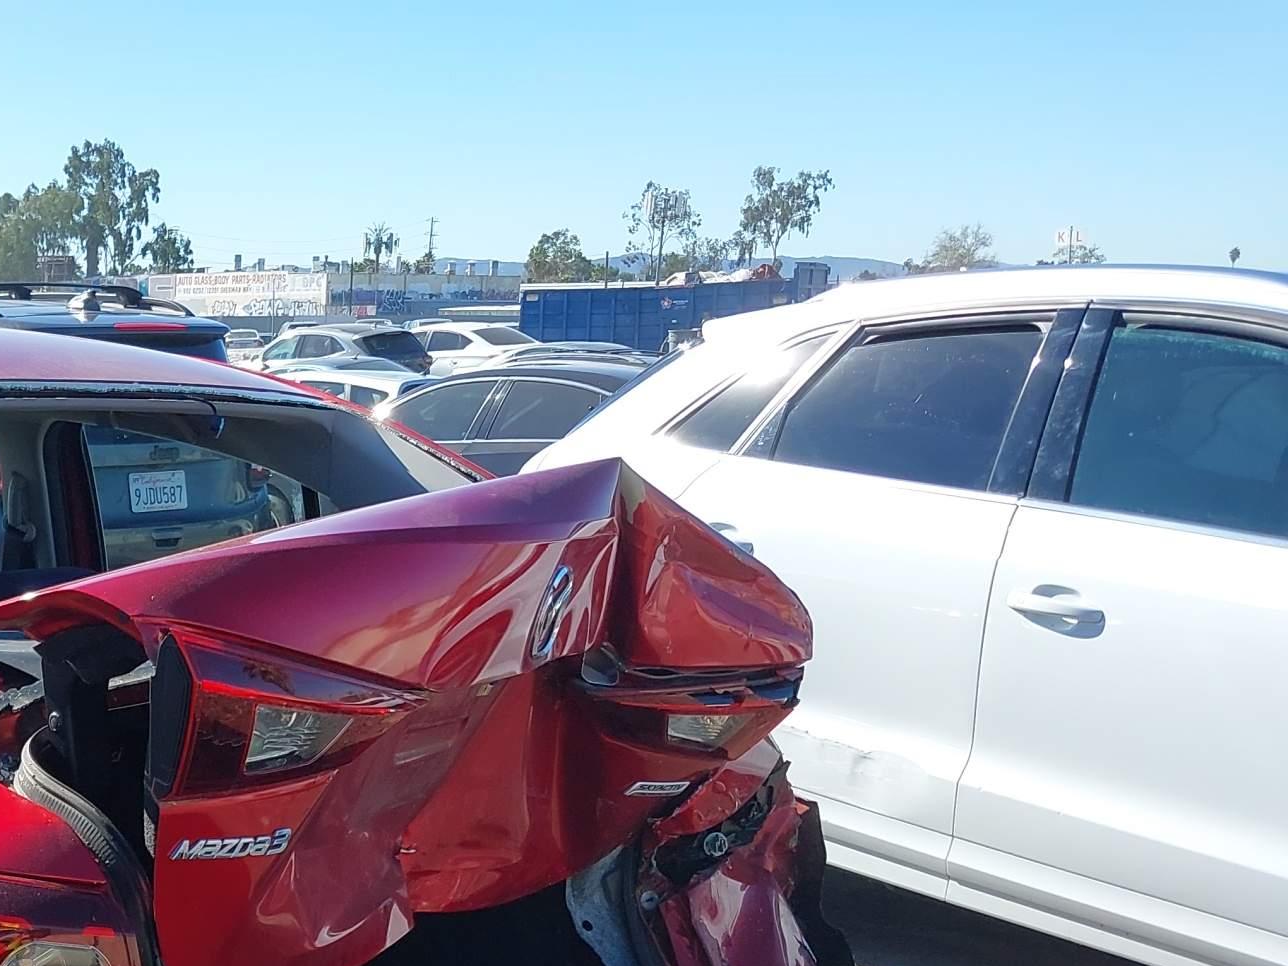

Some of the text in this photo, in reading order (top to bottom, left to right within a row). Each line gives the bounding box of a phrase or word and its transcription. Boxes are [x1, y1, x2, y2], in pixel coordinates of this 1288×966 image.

[1057, 231, 1065, 243] K
[1076, 231, 1083, 242] L
[178, 275, 193, 286] AUTO
[149, 444, 180, 462] Jeep
[134, 485, 183, 506] 9JDU587
